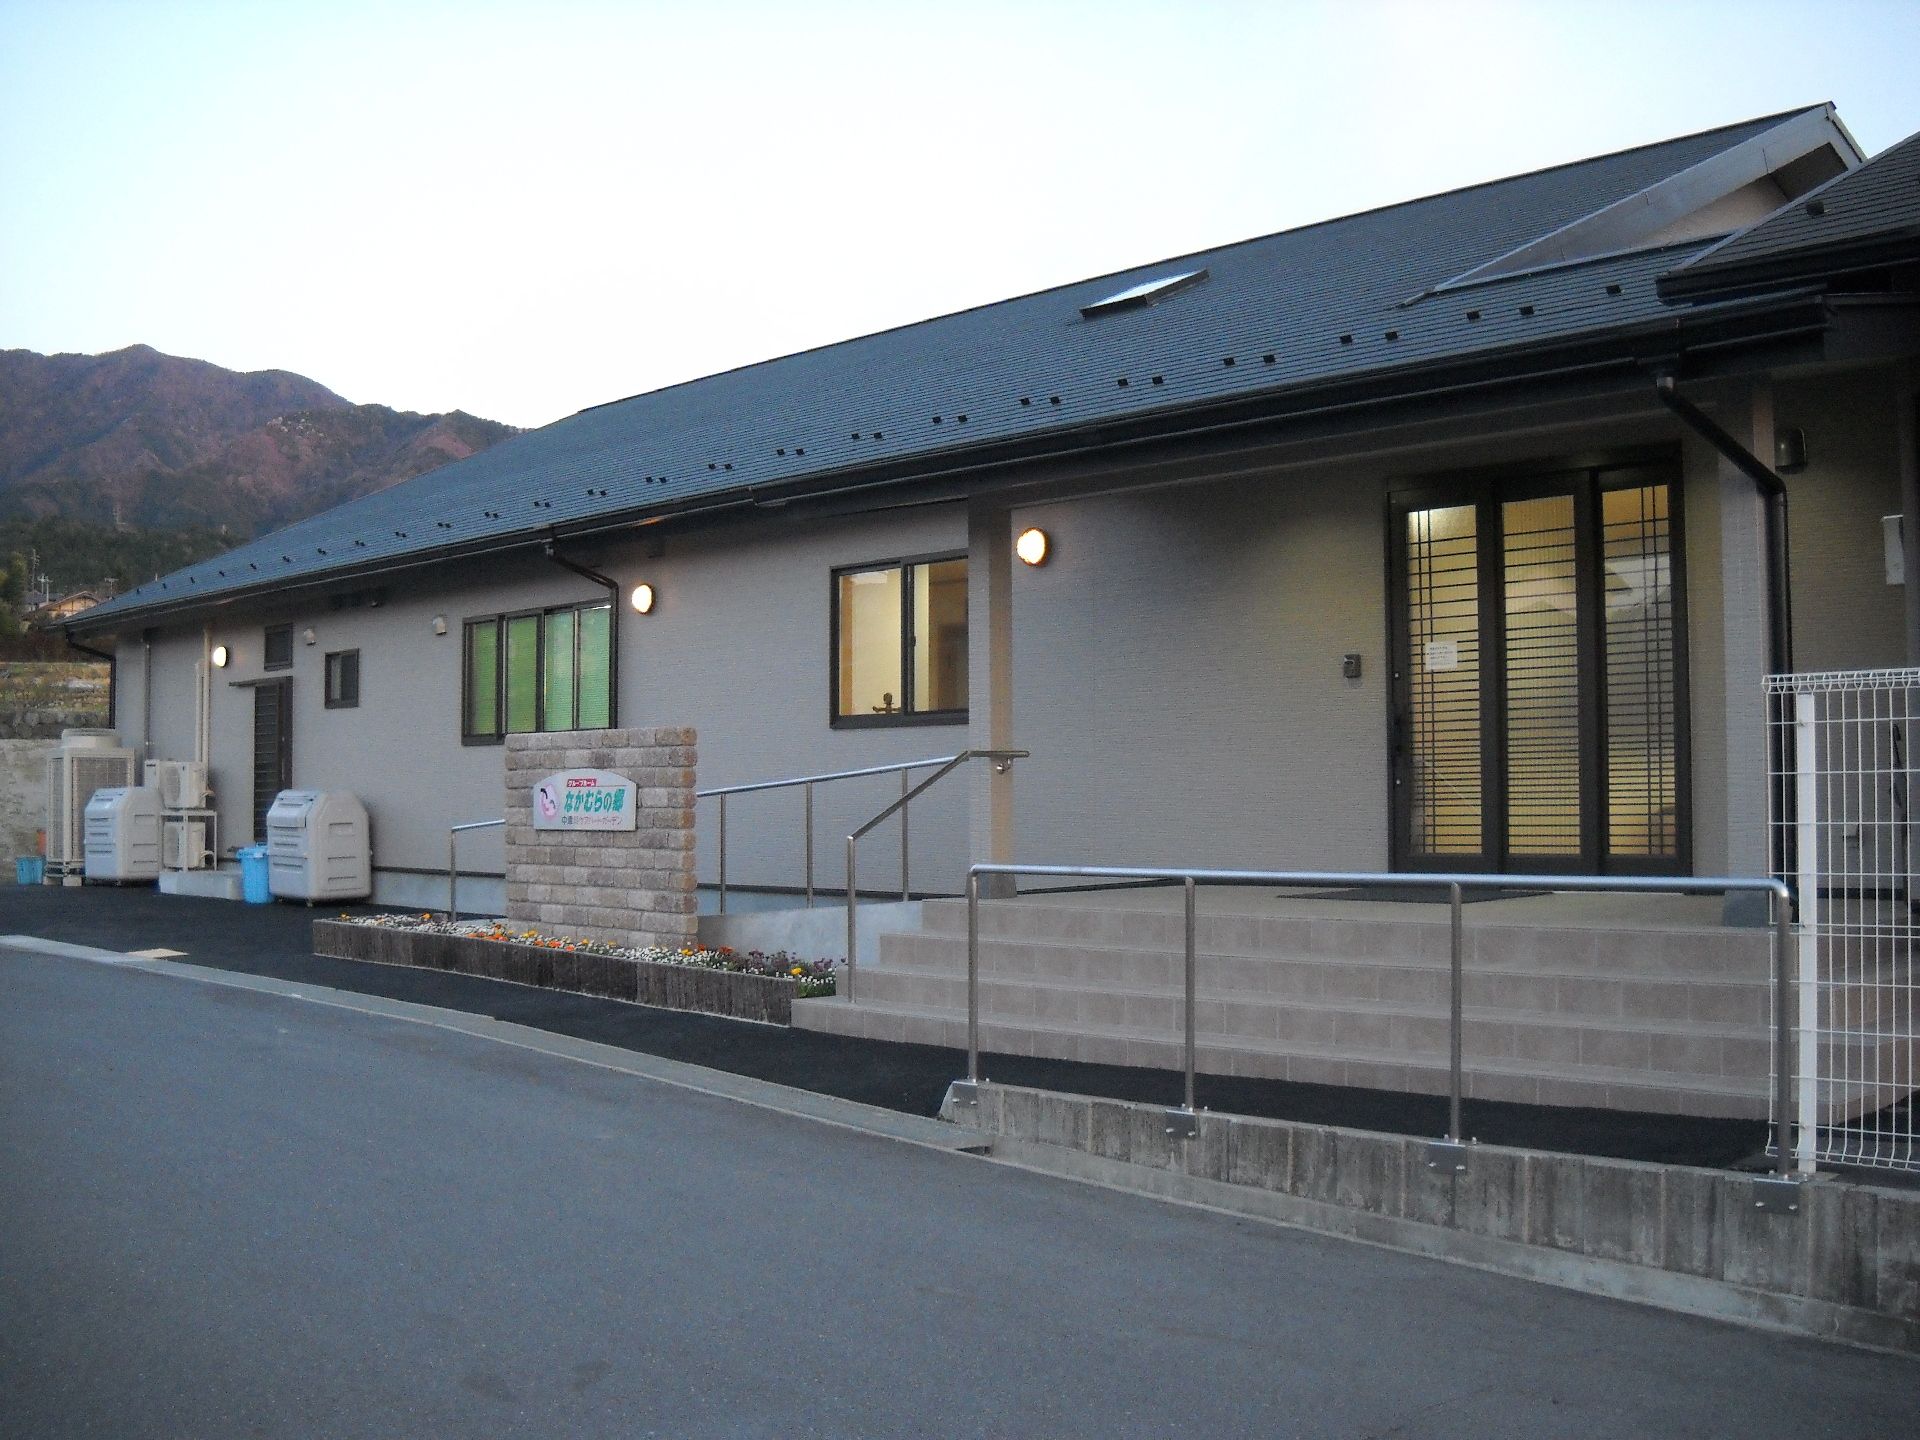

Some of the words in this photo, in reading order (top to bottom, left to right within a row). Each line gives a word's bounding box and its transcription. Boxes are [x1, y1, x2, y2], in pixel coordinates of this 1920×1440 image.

[564, 788, 625, 812] なかむらの郷
